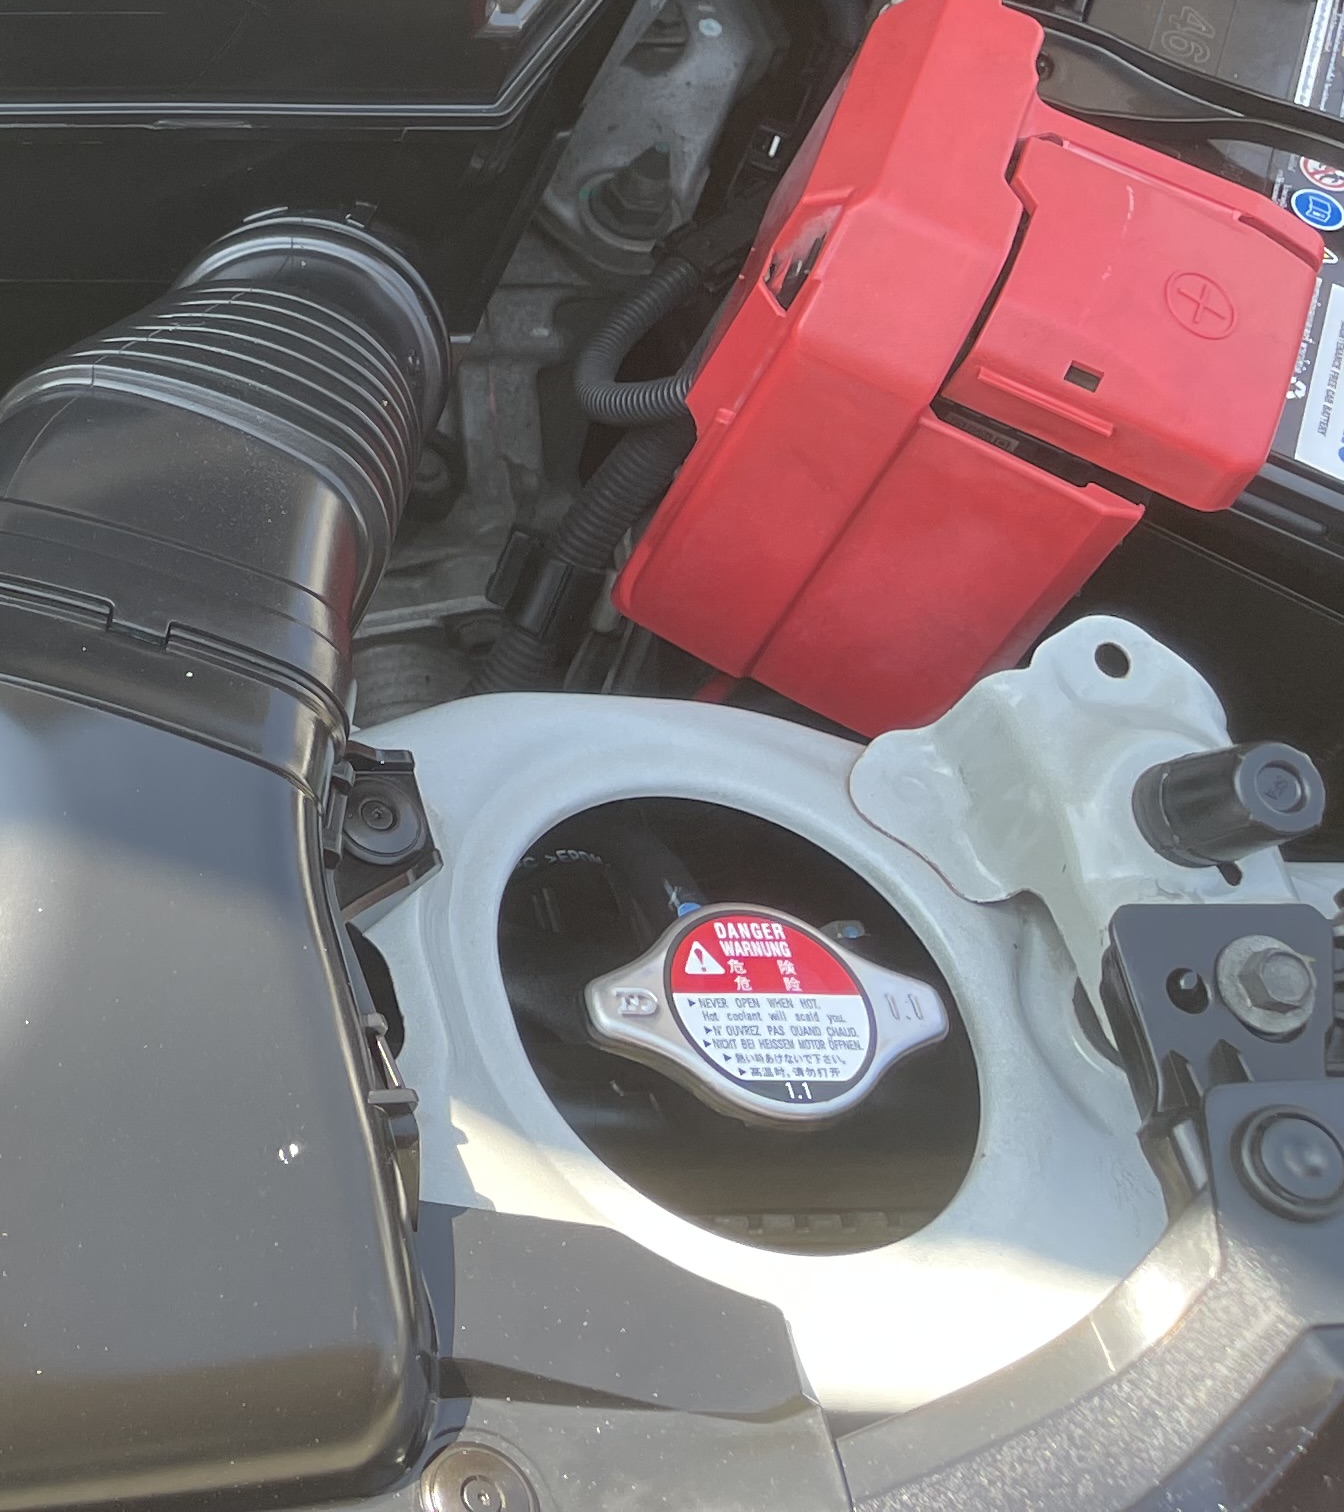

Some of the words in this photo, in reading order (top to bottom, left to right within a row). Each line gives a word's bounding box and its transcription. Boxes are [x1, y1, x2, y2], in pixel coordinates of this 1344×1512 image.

[713, 921, 787, 940] DANGER
[719, 940, 793, 958] WARNUNG
[699, 997, 729, 1009] NEVER
[734, 997, 761, 1009] OPEN
[766, 997, 794, 1009] WHEN
[701, 1010, 719, 1022] Hot
[727, 1010, 763, 1022] coolant
[768, 1010, 788, 1022] will
[795, 1010, 820, 1022] scald
[725, 1025, 761, 1037] OUVREZ
[767, 1025, 785, 1037] PAS
[790, 1025, 822, 1037] QUAND
[712, 1038, 738, 1050] NICHT
[784, 1081, 813, 1101] 1.1
